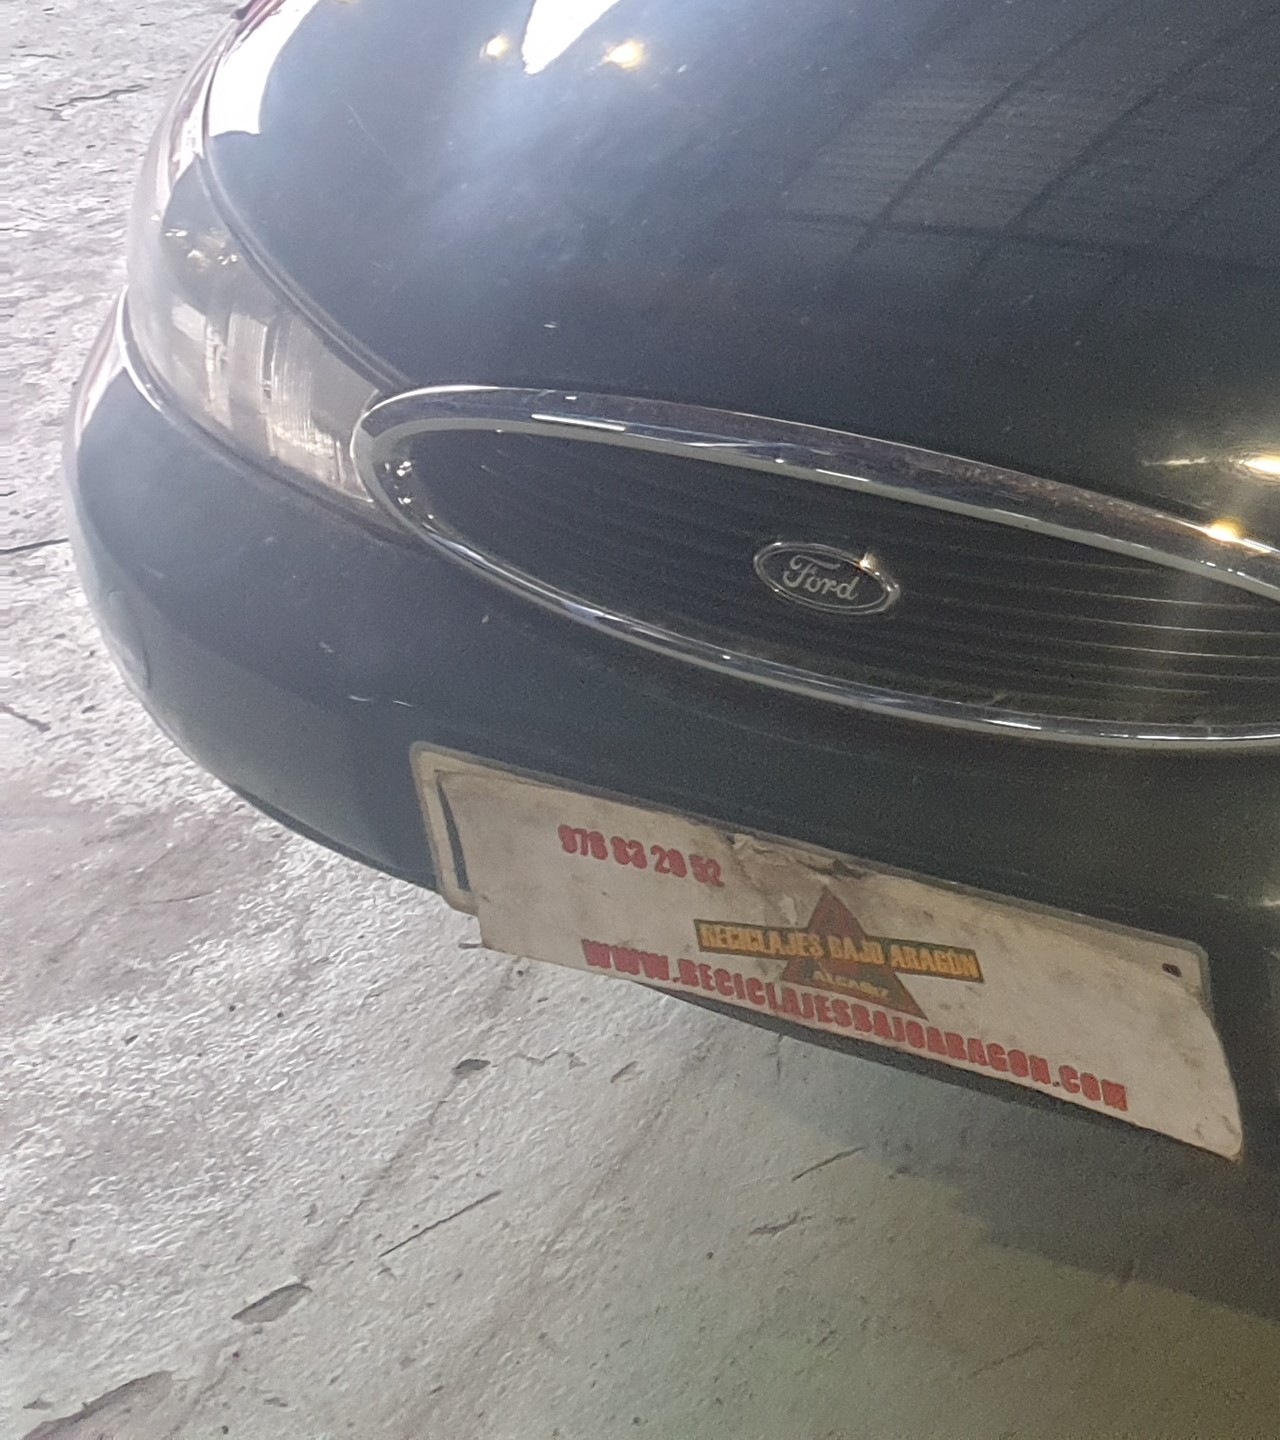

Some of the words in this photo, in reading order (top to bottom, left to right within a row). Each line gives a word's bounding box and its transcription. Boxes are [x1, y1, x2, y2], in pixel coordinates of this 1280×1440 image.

[782, 555, 858, 600] Ford
[700, 923, 824, 958] RECICLAJES
[827, 935, 885, 966] BAJO
